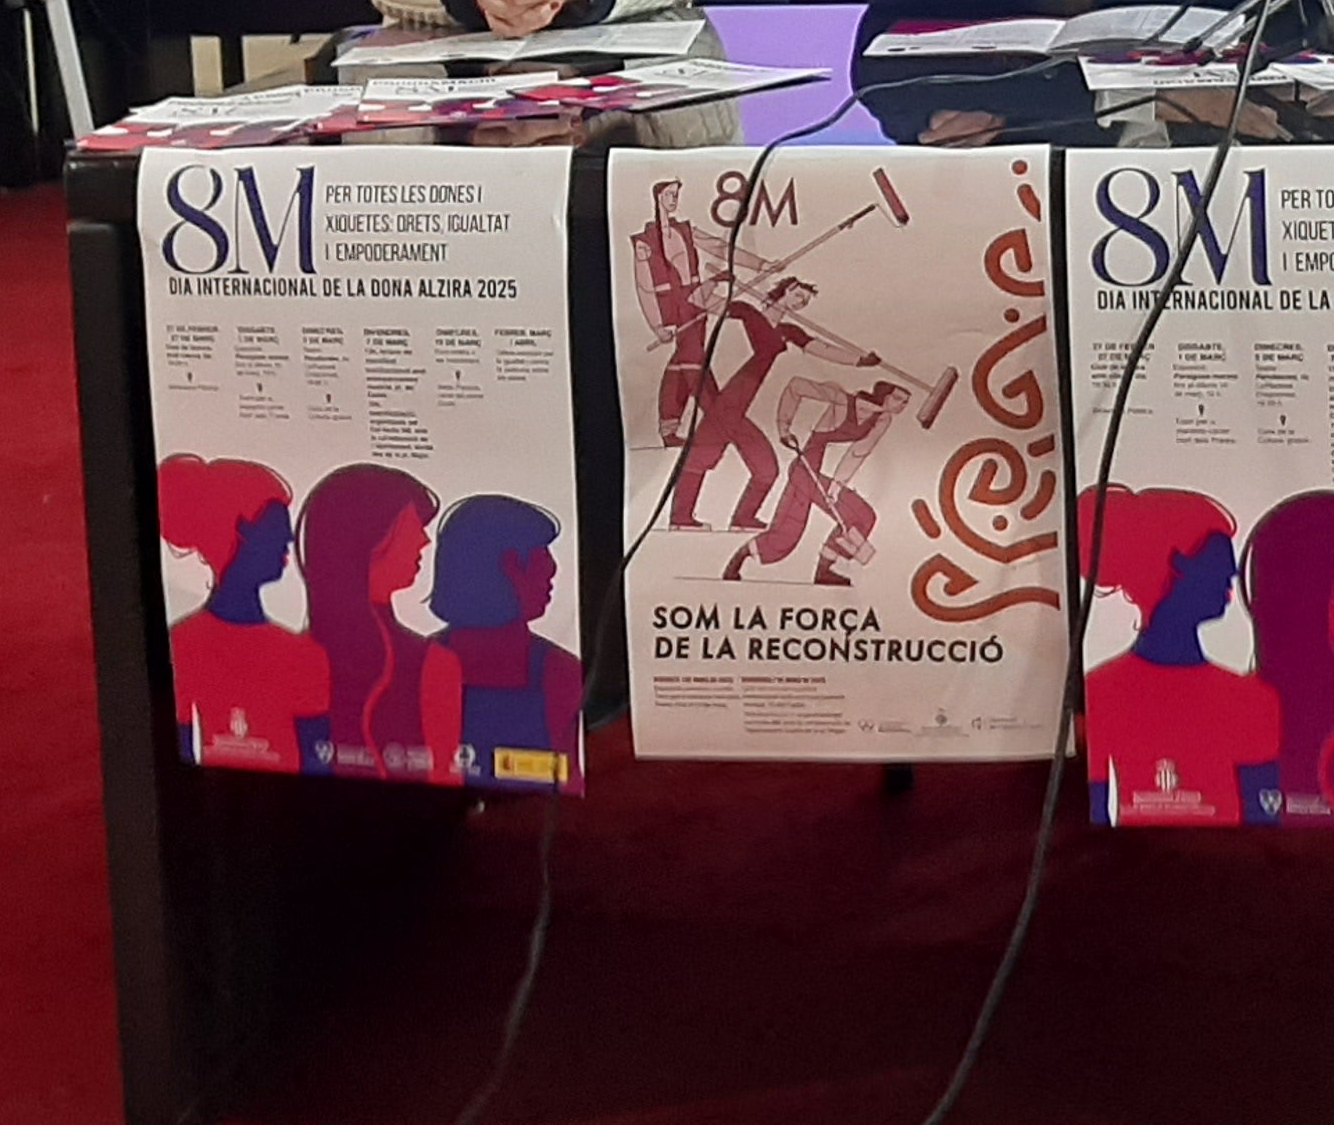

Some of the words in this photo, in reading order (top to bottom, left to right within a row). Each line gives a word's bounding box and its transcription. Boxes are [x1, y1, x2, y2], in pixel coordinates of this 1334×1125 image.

[325, 185, 351, 203] PER
[357, 185, 398, 203] TOTES
[401, 185, 426, 203] LES
[429, 185, 475, 203] DONES
[711, 170, 799, 228] 8M
[1281, 189, 1311, 209] PER
[162, 164, 318, 275] 8M
[325, 214, 394, 233] XIQUETES:
[397, 214, 444, 235] DRETS,
[447, 214, 511, 233] IGUALTAT
[1091, 167, 1273, 286] 8M
[336, 243, 448, 262] EMPODERAMENT
[169, 277, 193, 296] DIA
[197, 277, 318, 297] INTERNACIONAL
[323, 278, 342, 297] DE
[347, 278, 366, 297] LA
[371, 278, 413, 297] DONA
[418, 279, 472, 298] ALZIRA
[477, 279, 517, 298] 2025
[1097, 290, 1126, 310] DIA
[1279, 290, 1302, 310] DE
[1308, 290, 1331, 310] LA
[653, 603, 720, 630] SOM
[733, 606, 767, 630] LA
[780, 607, 881, 636] FORÇA
[654, 637, 690, 659] DE
[702, 637, 736, 660] LA
[748, 635, 1004, 663] RECONSTRUCCIÓ
